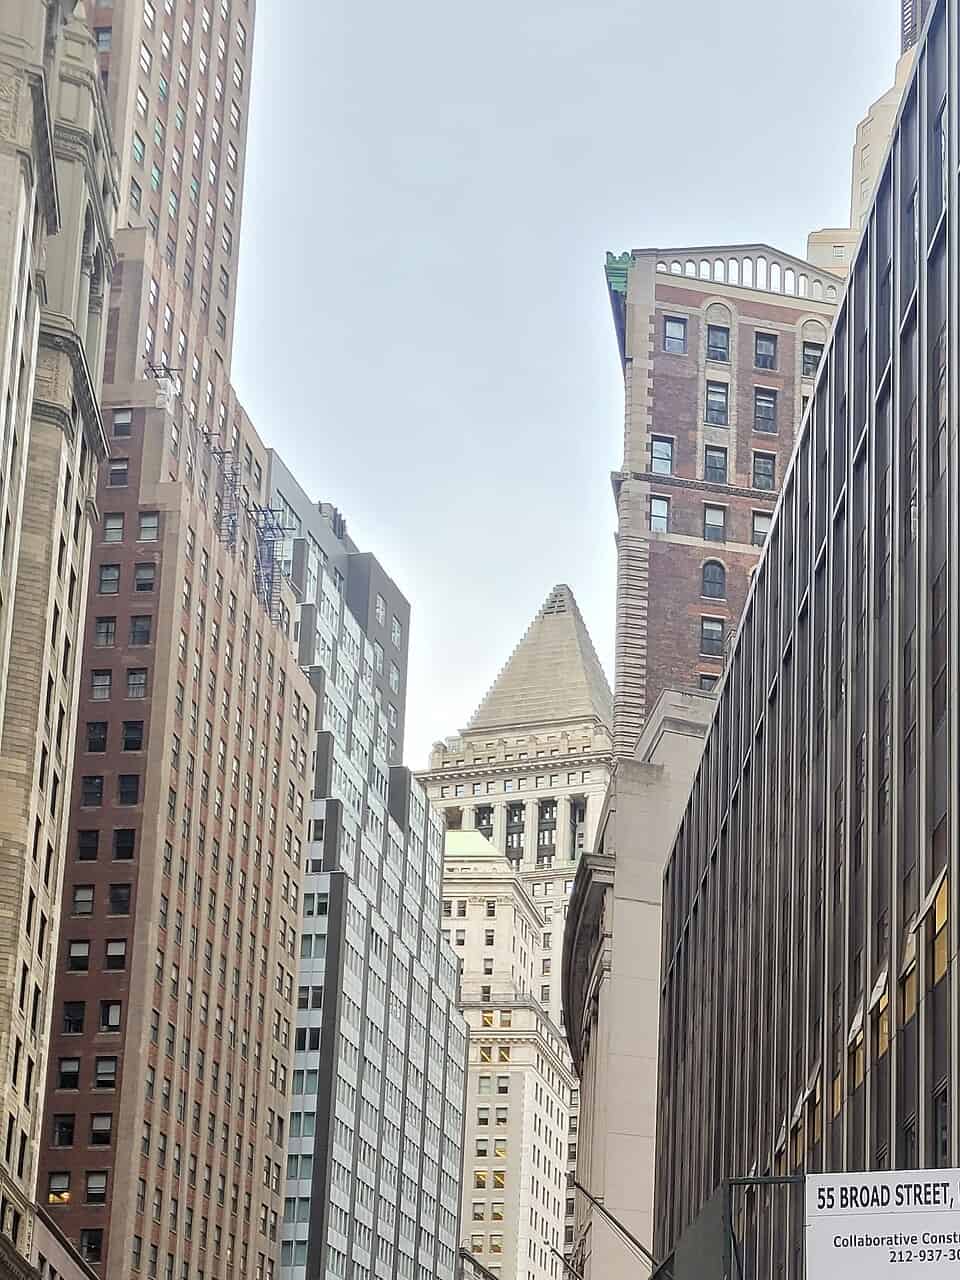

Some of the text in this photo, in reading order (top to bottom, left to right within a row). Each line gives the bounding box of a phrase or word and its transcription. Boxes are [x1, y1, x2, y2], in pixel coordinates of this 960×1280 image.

[817, 1187, 834, 1209] 55
[840, 1185, 890, 1209] BROAD
[895, 1183, 954, 1208] STREET,
[834, 1233, 918, 1248] Collaborative
